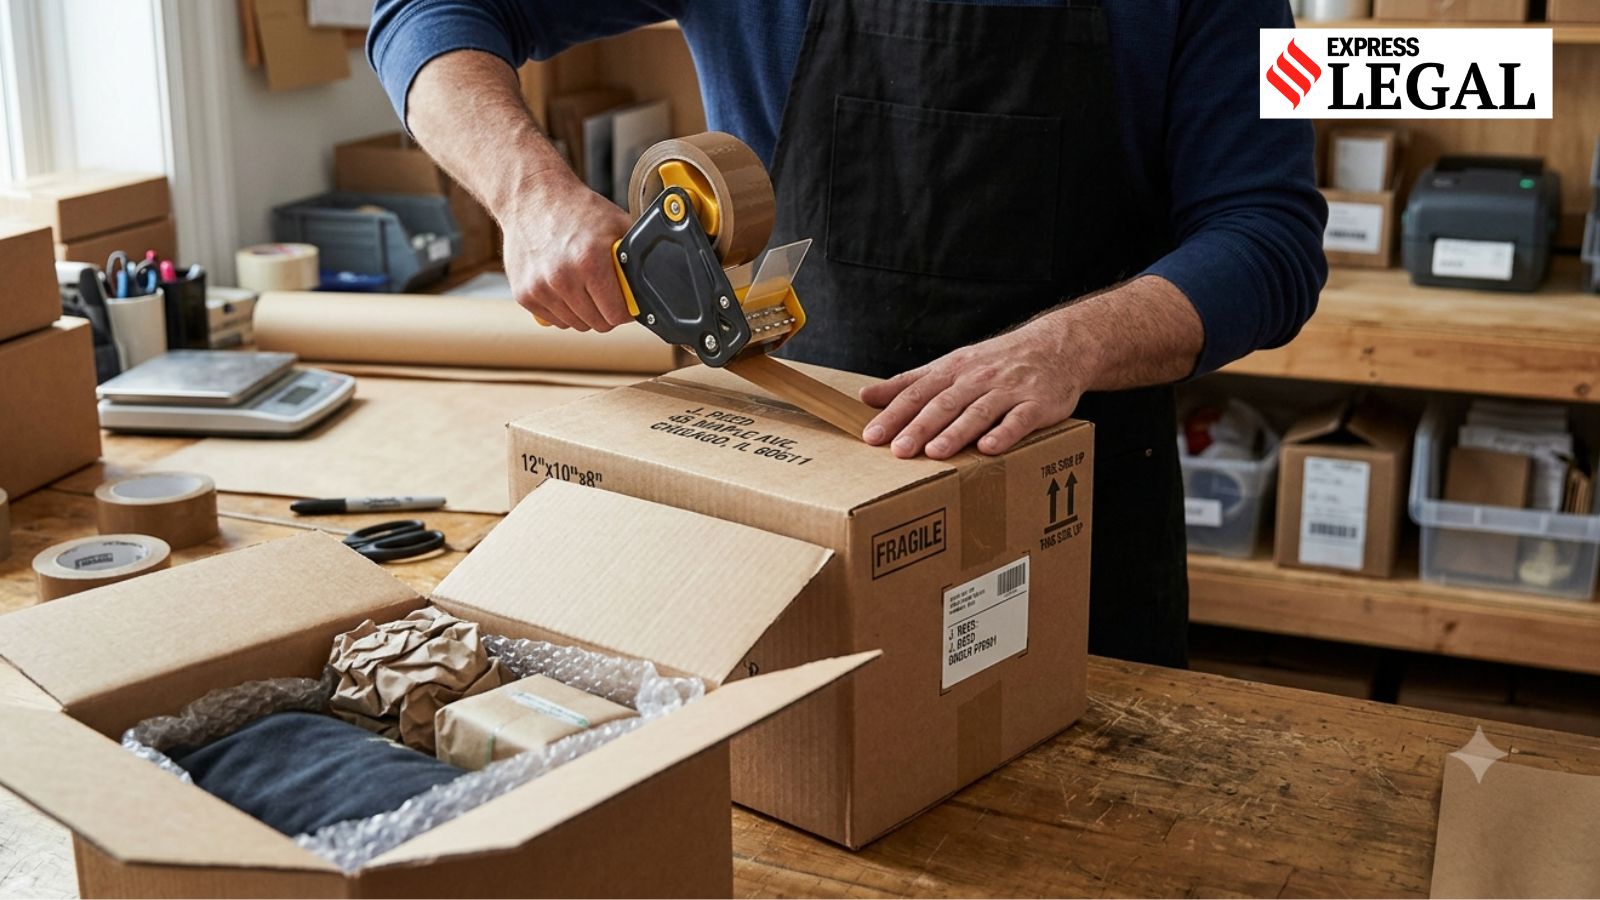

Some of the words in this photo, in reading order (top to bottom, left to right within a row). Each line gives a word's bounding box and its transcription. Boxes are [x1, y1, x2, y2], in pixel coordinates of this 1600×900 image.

[705, 411, 755, 426] REED
[732, 442, 752, 452] IL
[1072, 521, 1084, 536] UP
[876, 520, 943, 568] FRAGILE
